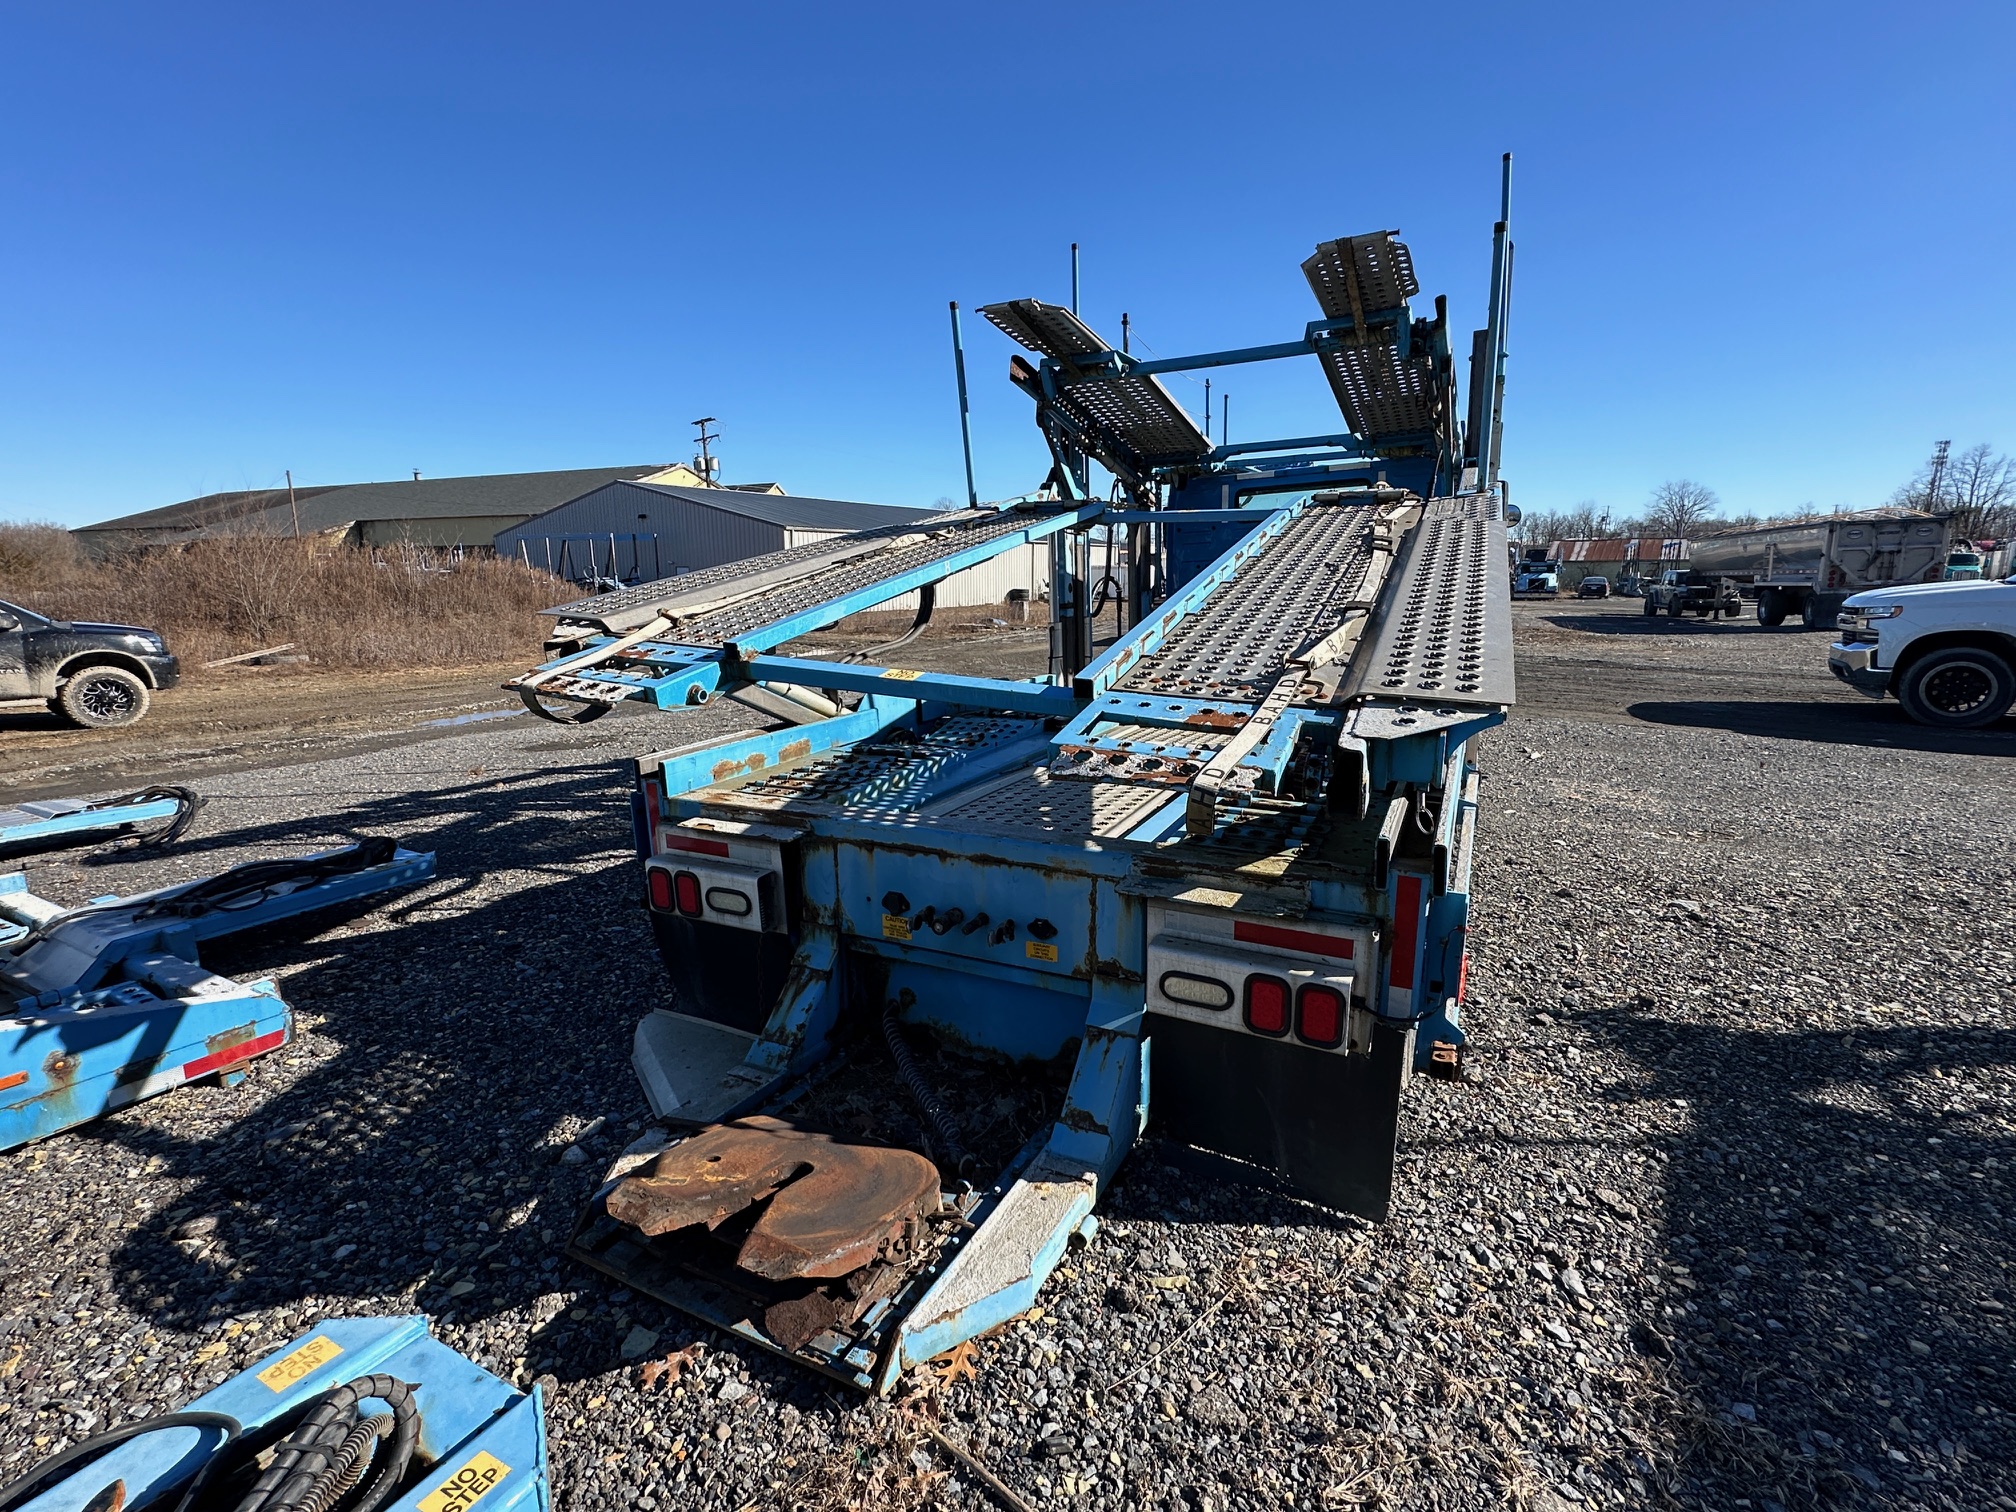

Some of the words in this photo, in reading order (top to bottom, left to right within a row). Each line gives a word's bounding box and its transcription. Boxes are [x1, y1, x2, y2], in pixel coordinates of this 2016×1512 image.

[268, 1341, 324, 1379] STEP
[287, 1354, 322, 1379] NO
[440, 1467, 478, 1499] NO
[441, 1467, 498, 1512] STEP
